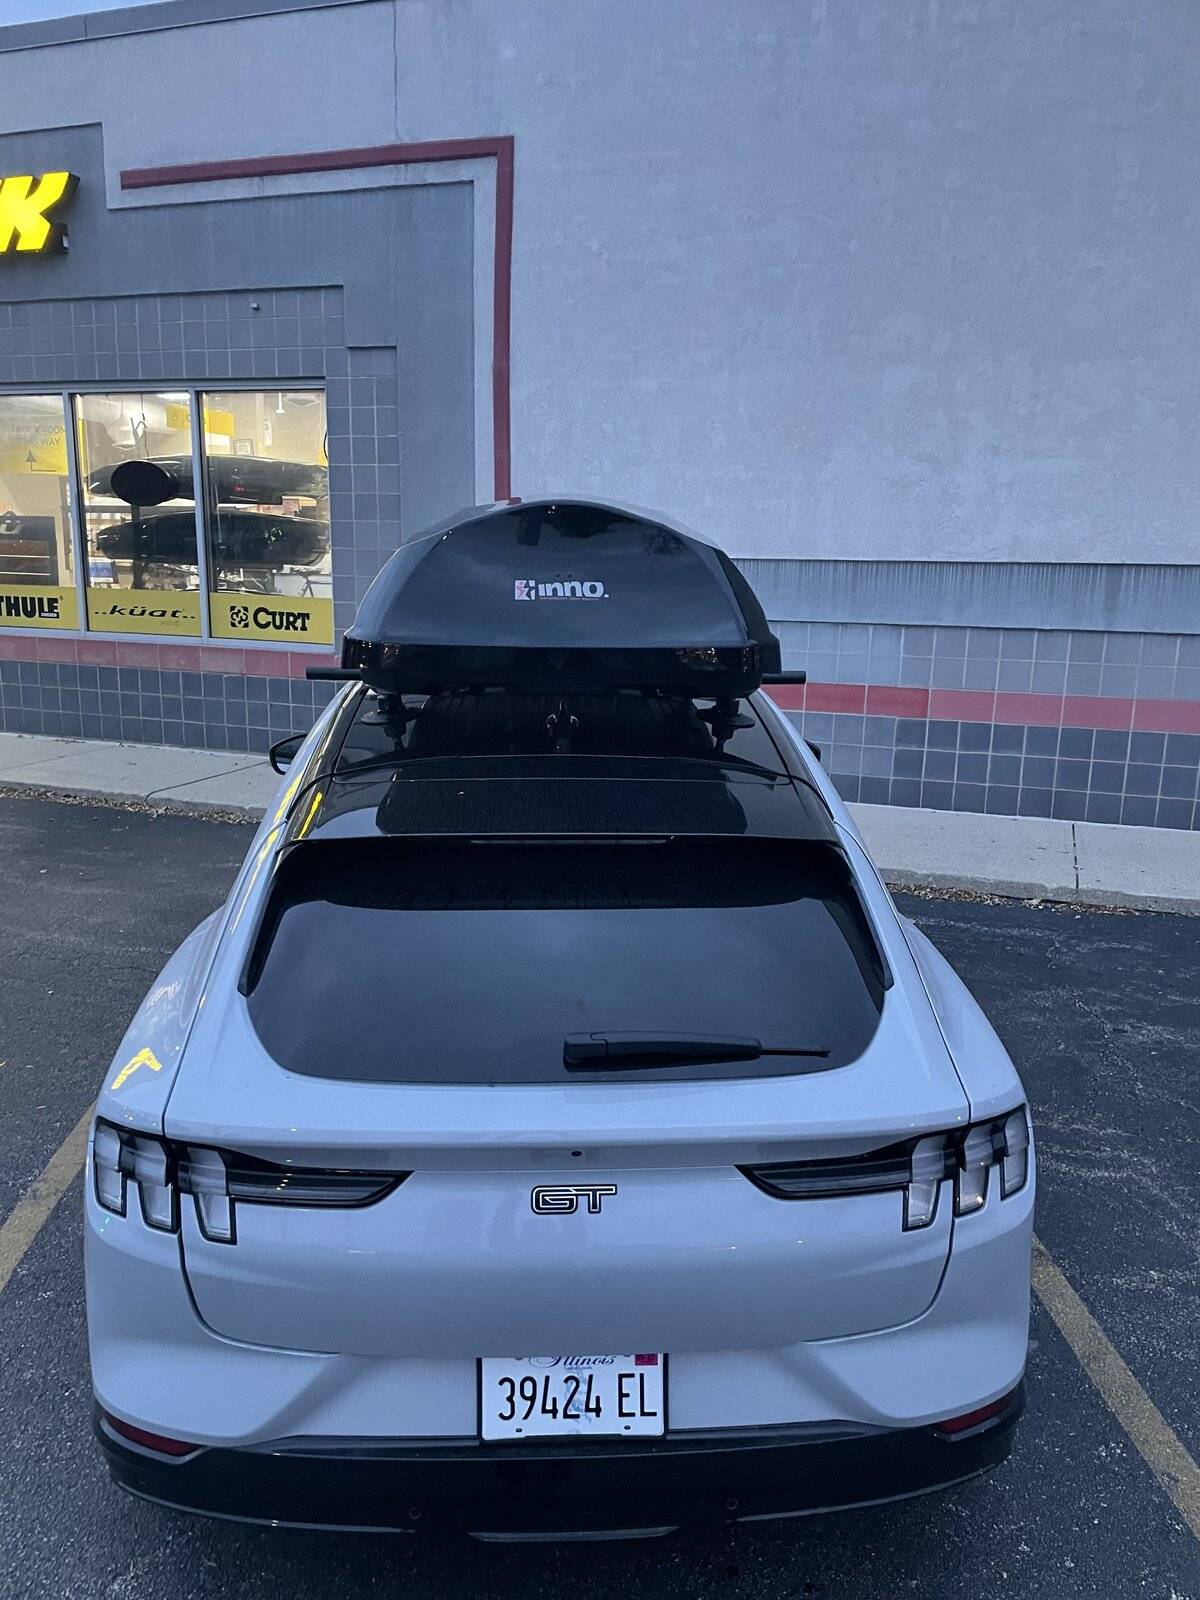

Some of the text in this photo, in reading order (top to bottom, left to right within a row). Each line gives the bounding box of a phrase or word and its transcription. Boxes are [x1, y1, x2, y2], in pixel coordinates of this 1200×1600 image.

[531, 1184, 617, 1215] GT
[498, 1372, 658, 1421] 39424 EL
